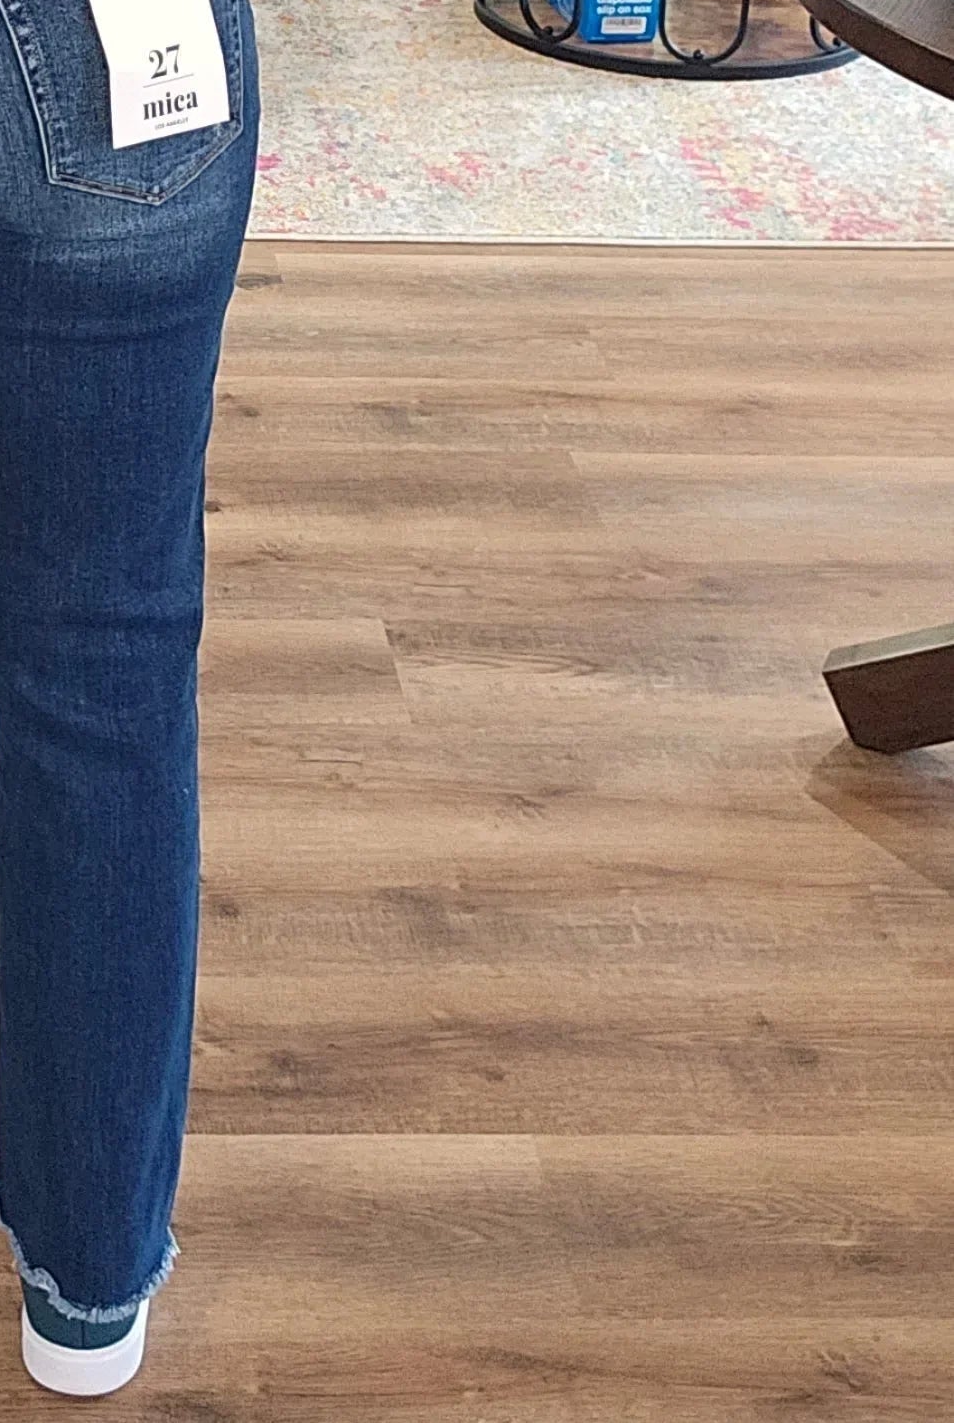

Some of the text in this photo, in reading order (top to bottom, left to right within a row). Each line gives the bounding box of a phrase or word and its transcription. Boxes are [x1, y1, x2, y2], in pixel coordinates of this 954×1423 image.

[596, 5, 615, 15] slip
[617, 5, 631, 14] on
[148, 43, 180, 79] 27
[143, 91, 198, 121] mica
